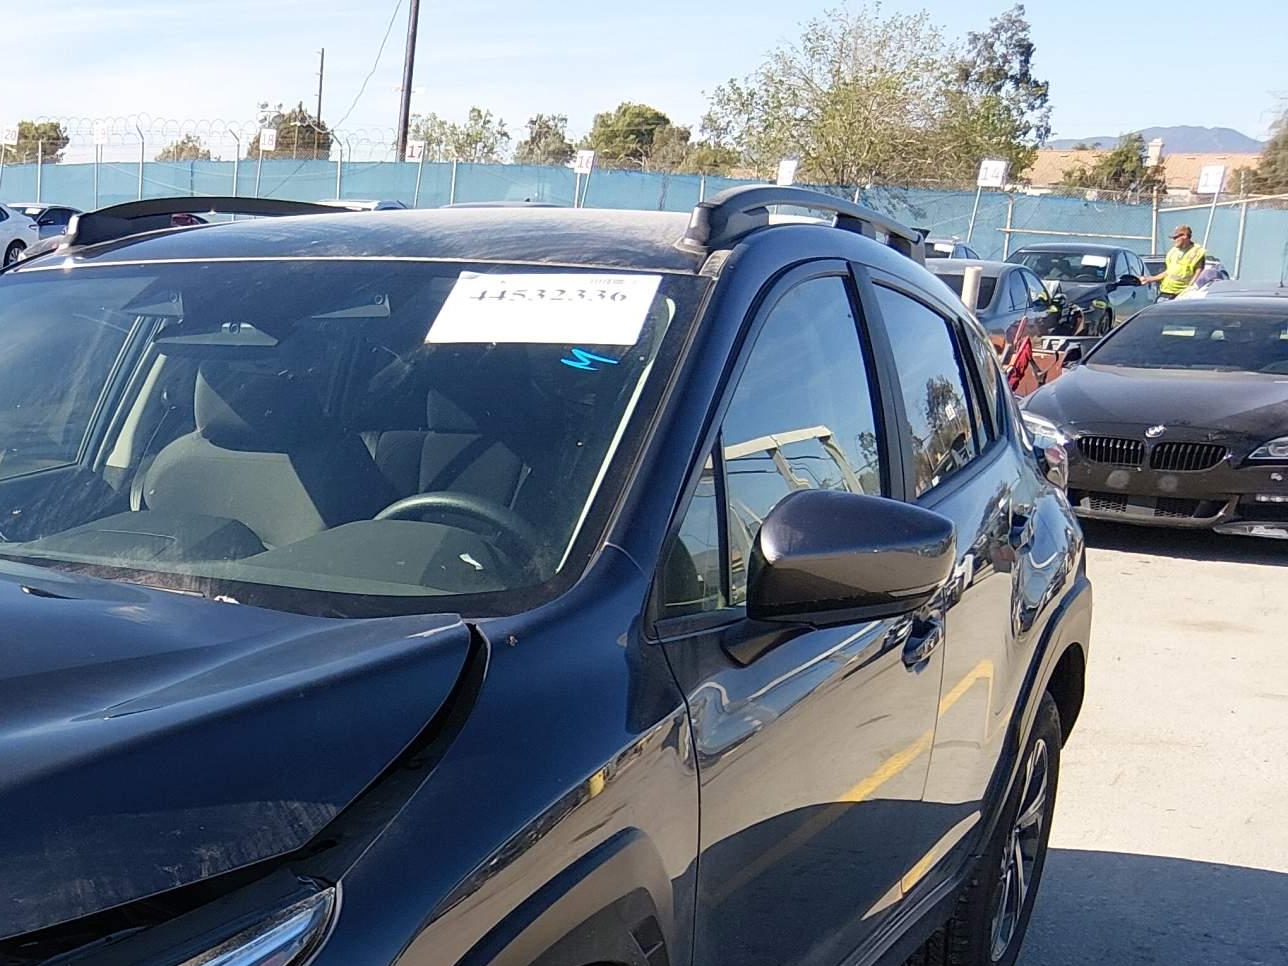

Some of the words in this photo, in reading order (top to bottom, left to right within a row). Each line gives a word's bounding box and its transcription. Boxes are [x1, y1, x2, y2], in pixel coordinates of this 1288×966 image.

[262, 134, 274, 146] 18
[407, 145, 423, 159] 17
[469, 288, 628, 302] 44532336
